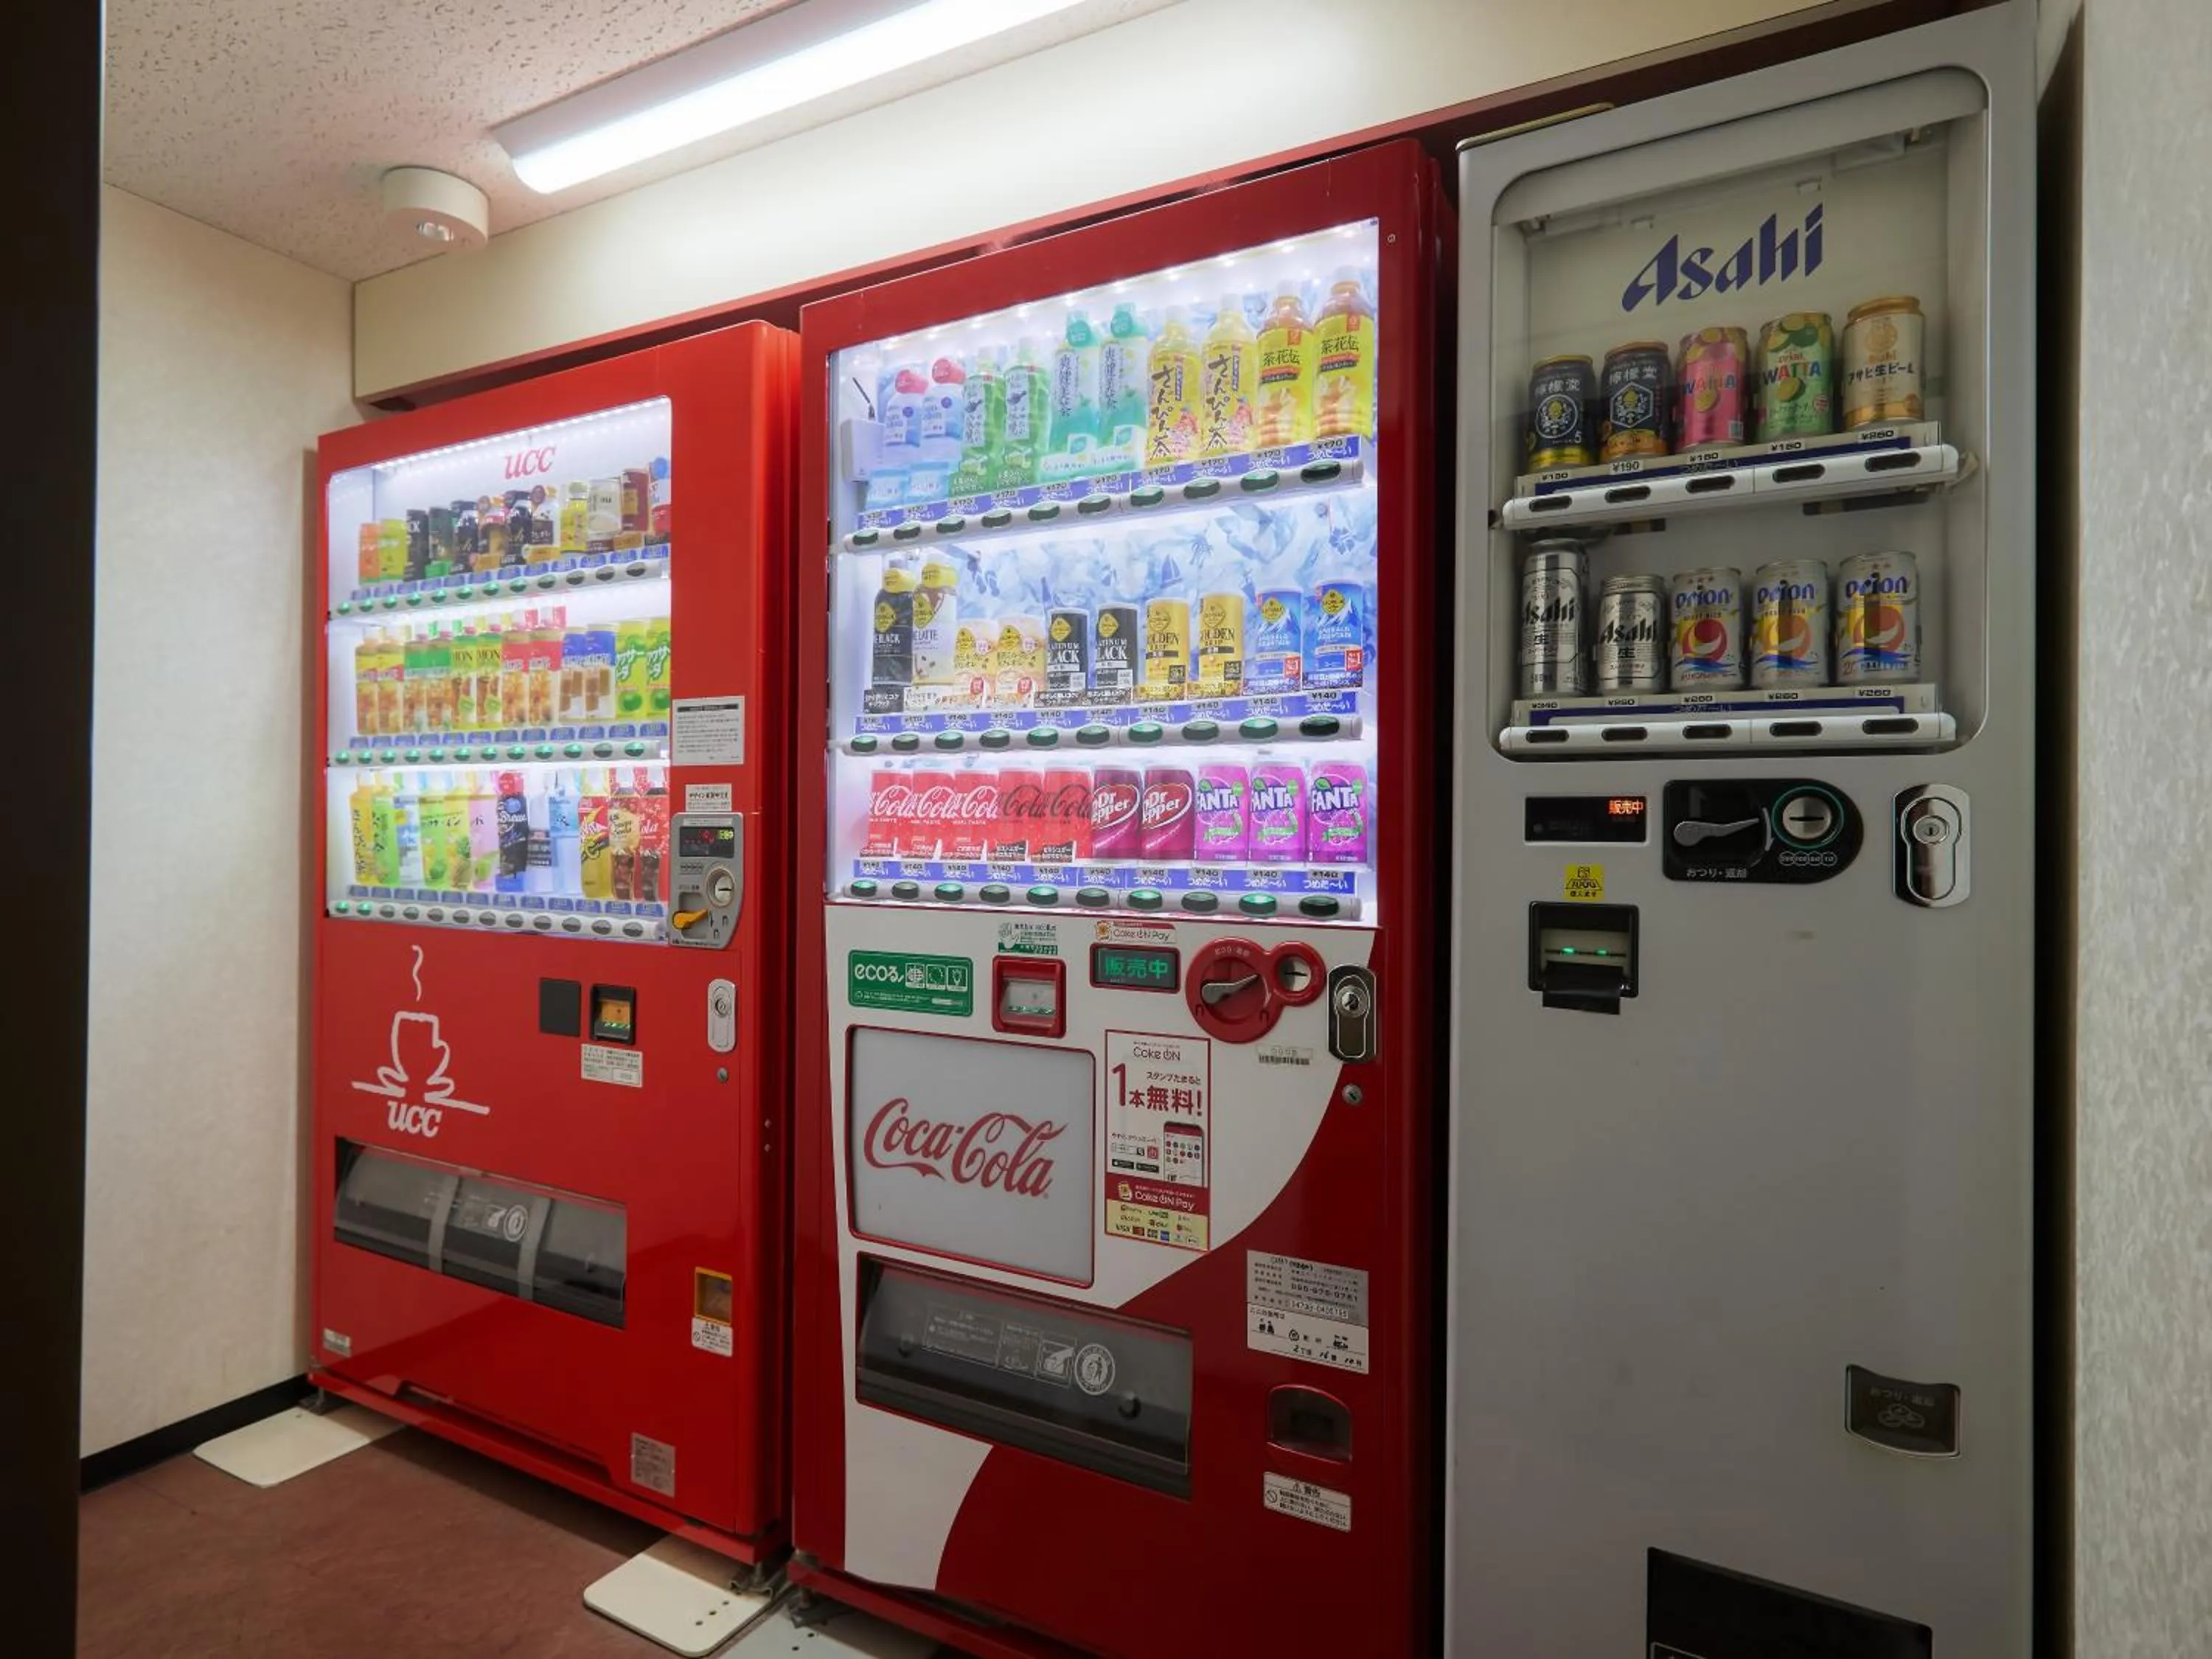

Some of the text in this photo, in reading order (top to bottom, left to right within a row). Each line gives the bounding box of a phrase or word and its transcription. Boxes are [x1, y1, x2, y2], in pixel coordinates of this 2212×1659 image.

[1623, 203, 1823, 313] Asahi
[1763, 361, 1822, 386] WATTA
[1099, 790, 1117, 806] Dr
[1148, 790, 1167, 807] Dr
[1608, 799, 1644, 815] 販売中
[1106, 957, 1168, 980] 販売中
[1133, 1046, 1180, 1061] Coke ON
[863, 1097, 1068, 1197] Coca-Cola
[1176, 1198, 1194, 1211] Pay
